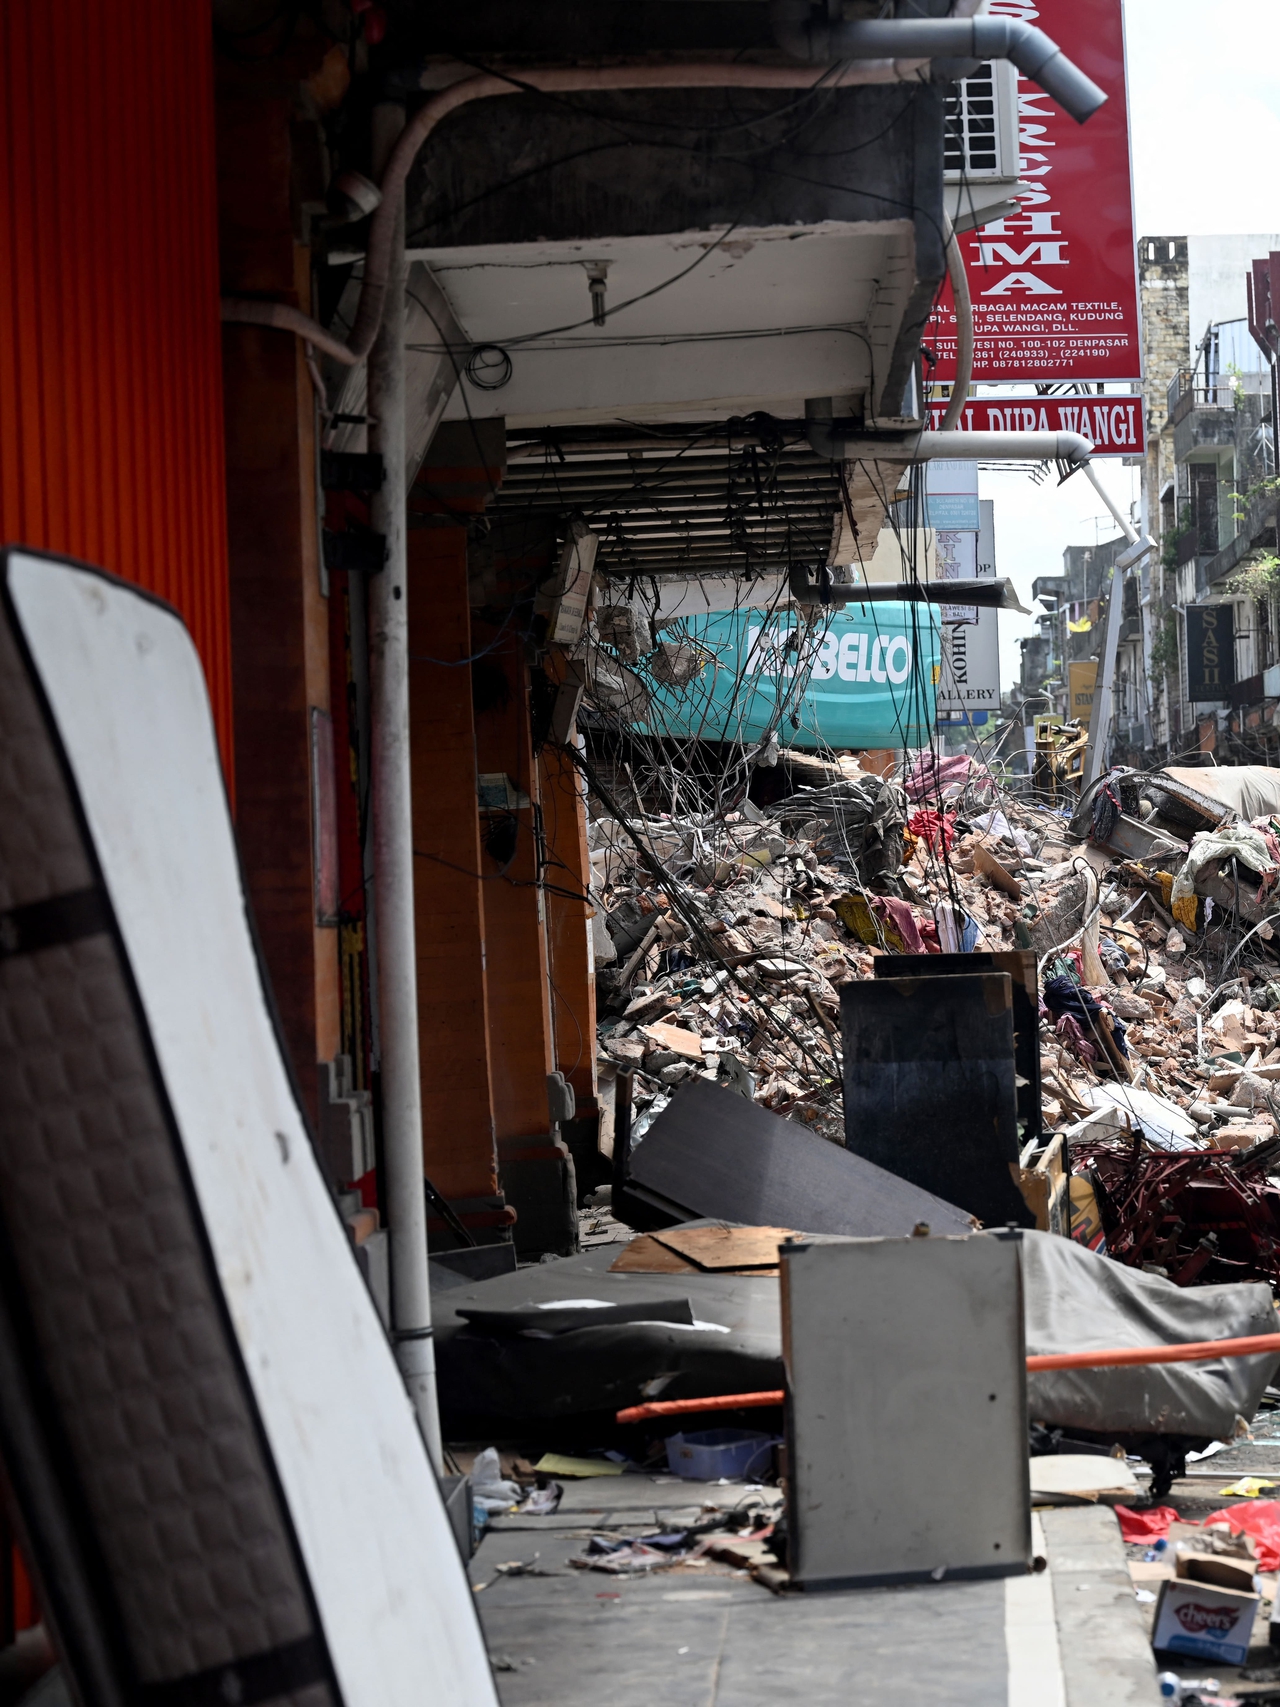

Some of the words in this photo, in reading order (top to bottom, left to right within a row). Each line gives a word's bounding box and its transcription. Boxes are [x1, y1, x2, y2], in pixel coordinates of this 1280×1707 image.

[954, 303, 1017, 312] RBAGAI
[1020, 303, 1067, 311] MACAM
[1071, 302, 1122, 311] TEXTILE,
[949, 315, 982, 324] SI,
[986, 314, 1066, 322] SELENDANG,
[1070, 312, 1124, 321] KUDUNG
[974, 324, 1000, 333] UPA
[1002, 324, 1049, 333] WANGI,
[1052, 323, 1079, 332] DLL.
[936, 341, 995, 350] SULESI
[998, 341, 1017, 349] NO.
[1021, 340, 1066, 348] 100-102
[1069, 339, 1129, 347] DENPASAR
[972, 350, 994, 358] 361
[999, 350, 1049, 359] (240933)
[1060, 349, 1110, 358] (224190)
[973, 360, 989, 368] HP.
[992, 359, 1074, 368] 087812802771
[987, 407, 1050, 431] DUPA
[1058, 405, 1136, 445] WANGI
[745, 626, 913, 685] KOBELCO
[937, 689, 996, 700] ALLERY
